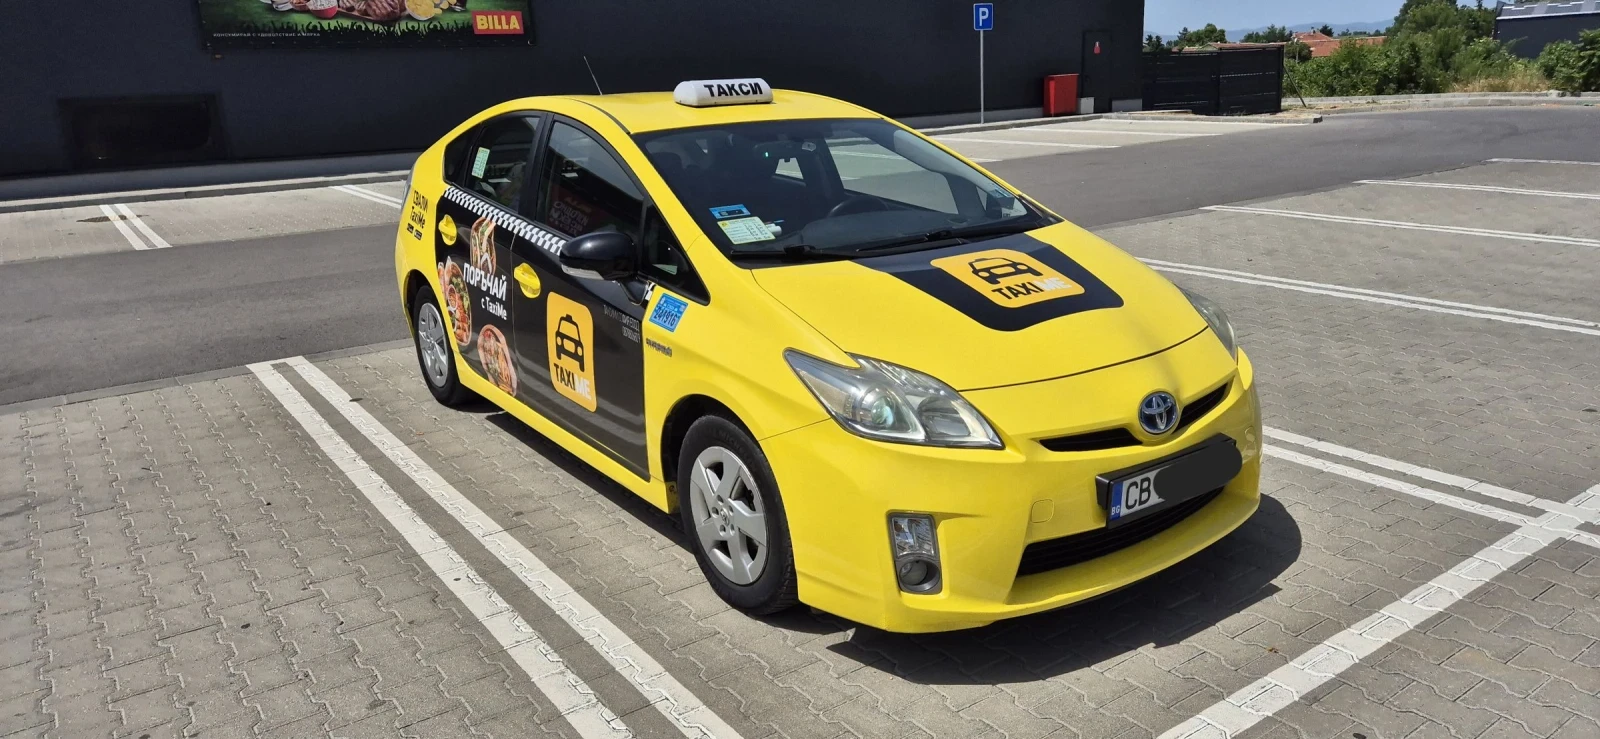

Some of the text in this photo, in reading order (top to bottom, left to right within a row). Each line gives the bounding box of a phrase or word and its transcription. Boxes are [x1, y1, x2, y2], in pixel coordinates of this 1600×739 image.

[475, 15, 520, 30] BILLA
[979, 7, 989, 27] P
[703, 82, 763, 98] ТАКСИ
[413, 190, 429, 213] СВАЛИ
[410, 206, 426, 229] TaxiMe
[463, 262, 507, 301] ПОРЪЧАЙ
[485, 296, 507, 320] TaxiMe
[1125, 476, 1151, 510] CB
[1111, 505, 1120, 515] BG
